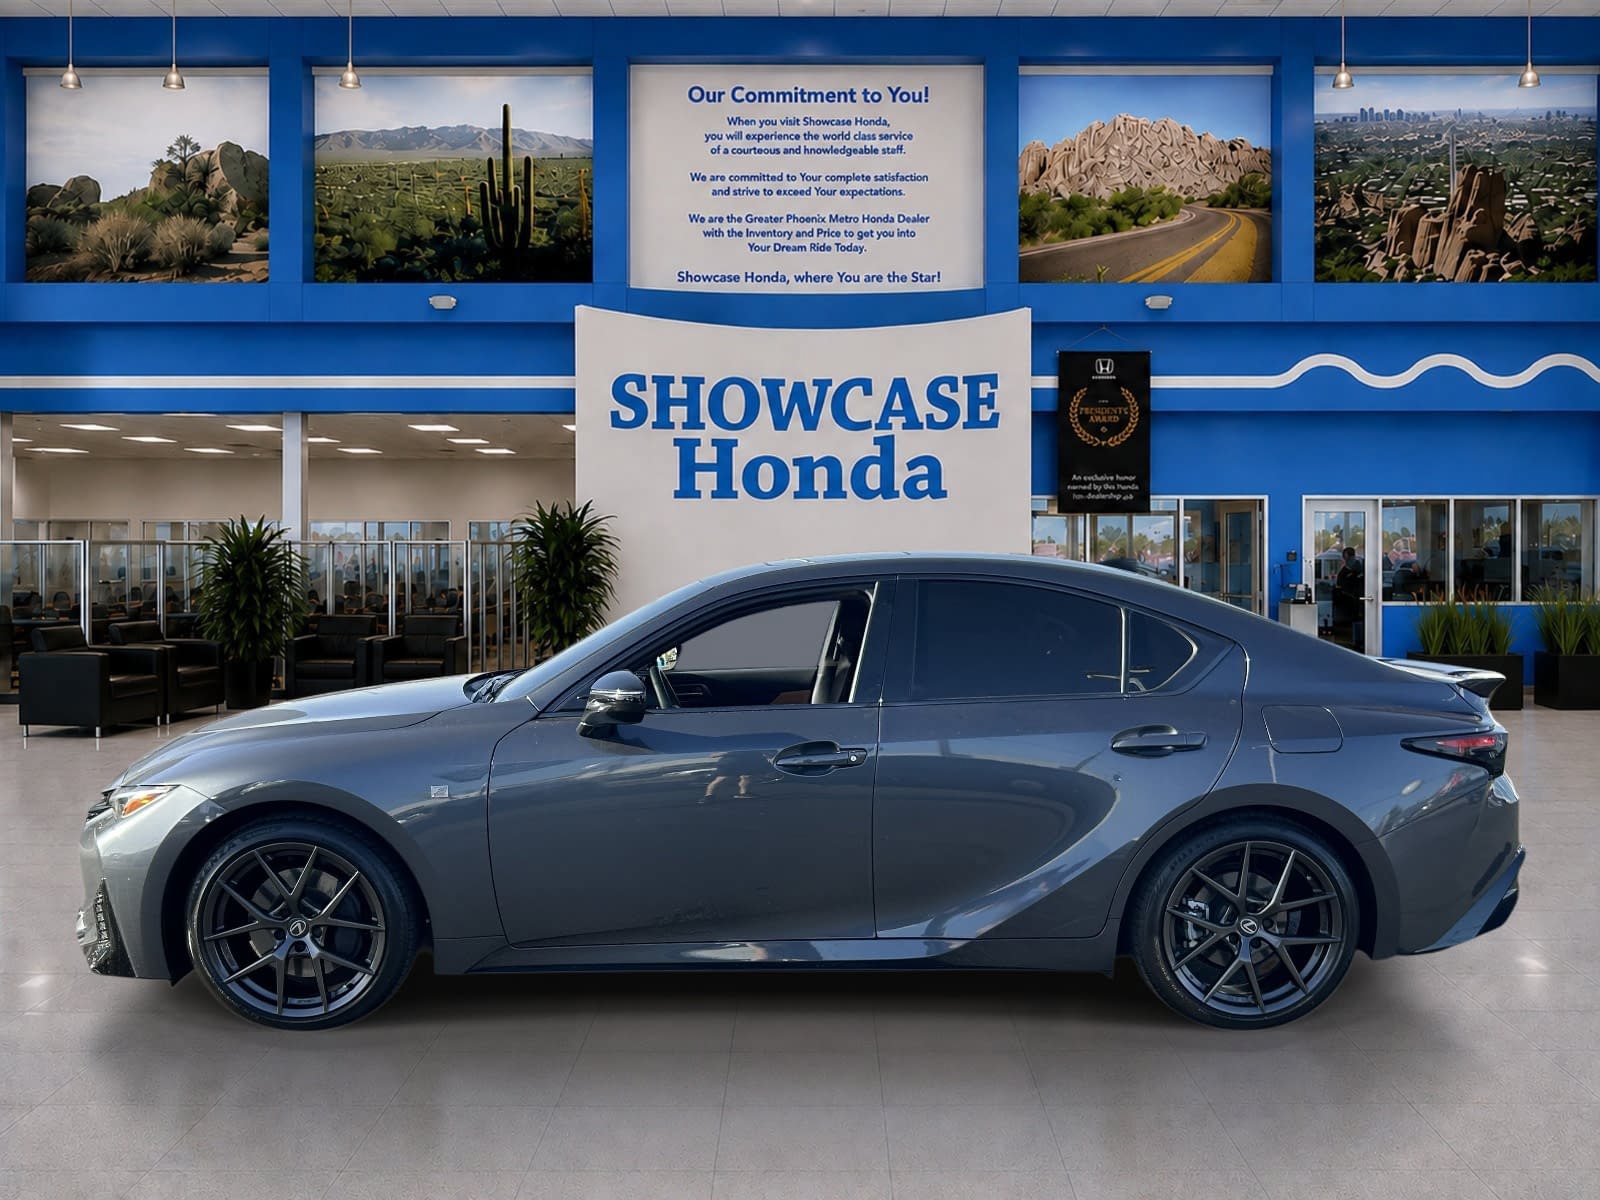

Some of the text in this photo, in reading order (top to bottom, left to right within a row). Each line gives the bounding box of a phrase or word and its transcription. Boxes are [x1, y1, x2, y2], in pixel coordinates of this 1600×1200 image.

[688, 86, 928, 103] Our Commitment to You!
[726, 116, 891, 129] When you visit Showcase Honda,
[704, 130, 914, 144] you will experience the world class service
[710, 144, 722, 155] of
[722, 147, 730, 155] a
[730, 146, 781, 156] courteous
[782, 144, 802, 155] and
[689, 171, 929, 185] We are committed to Your complete satisfaction
[711, 185, 906, 200] and strive to exceed Your expectations.
[688, 213, 706, 224] We
[707, 216, 725, 224] are
[725, 213, 743, 224] the
[744, 213, 785, 224] Greater
[828, 213, 860, 224] Metro
[861, 213, 895, 224] Honda
[897, 213, 931, 224] Dealer
[702, 227, 917, 241] with the Inventory and Price to get you into
[747, 242, 868, 255] Your Dream Ride Today.
[677, 270, 941, 286] Showcase Honda, where You are the Star!
[610, 373, 1000, 431] SHOWCASE
[673, 434, 948, 500] Honda
